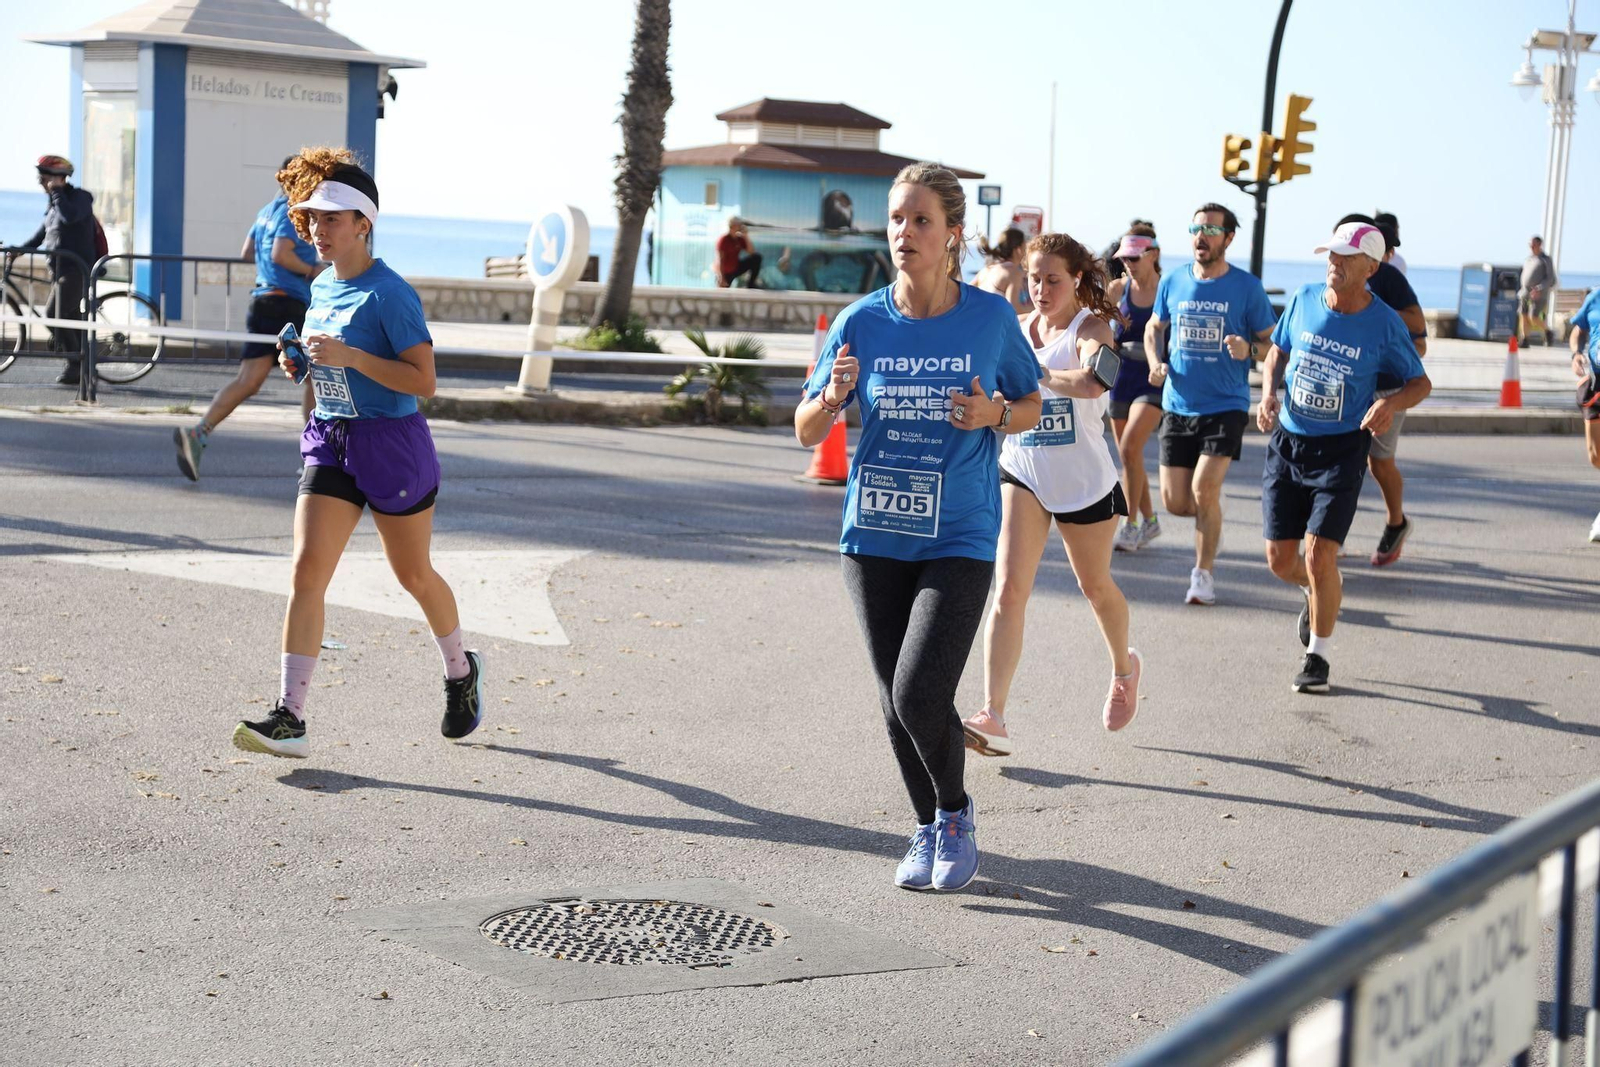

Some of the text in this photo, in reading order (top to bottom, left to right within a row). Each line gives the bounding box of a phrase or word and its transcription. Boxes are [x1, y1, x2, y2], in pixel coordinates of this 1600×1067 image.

[191, 75, 250, 96] Helados
[264, 81, 287, 98] Ice
[290, 84, 343, 104] Creams
[1178, 300, 1229, 314] mayoral
[1184, 328, 1216, 340] 1885
[1300, 330, 1361, 360] mayoral
[873, 354, 972, 377] mayoral
[1297, 349, 1352, 376] RUNNING
[1298, 366, 1340, 386] FRIEND
[315, 382, 346, 399] 1956
[872, 385, 965, 397] RUNNING
[879, 398, 954, 410] MAKES
[1297, 391, 1337, 409] 1803
[870, 479, 898, 488] Solidaria
[871, 473, 894, 481] Carrera
[866, 490, 928, 514] 1705
